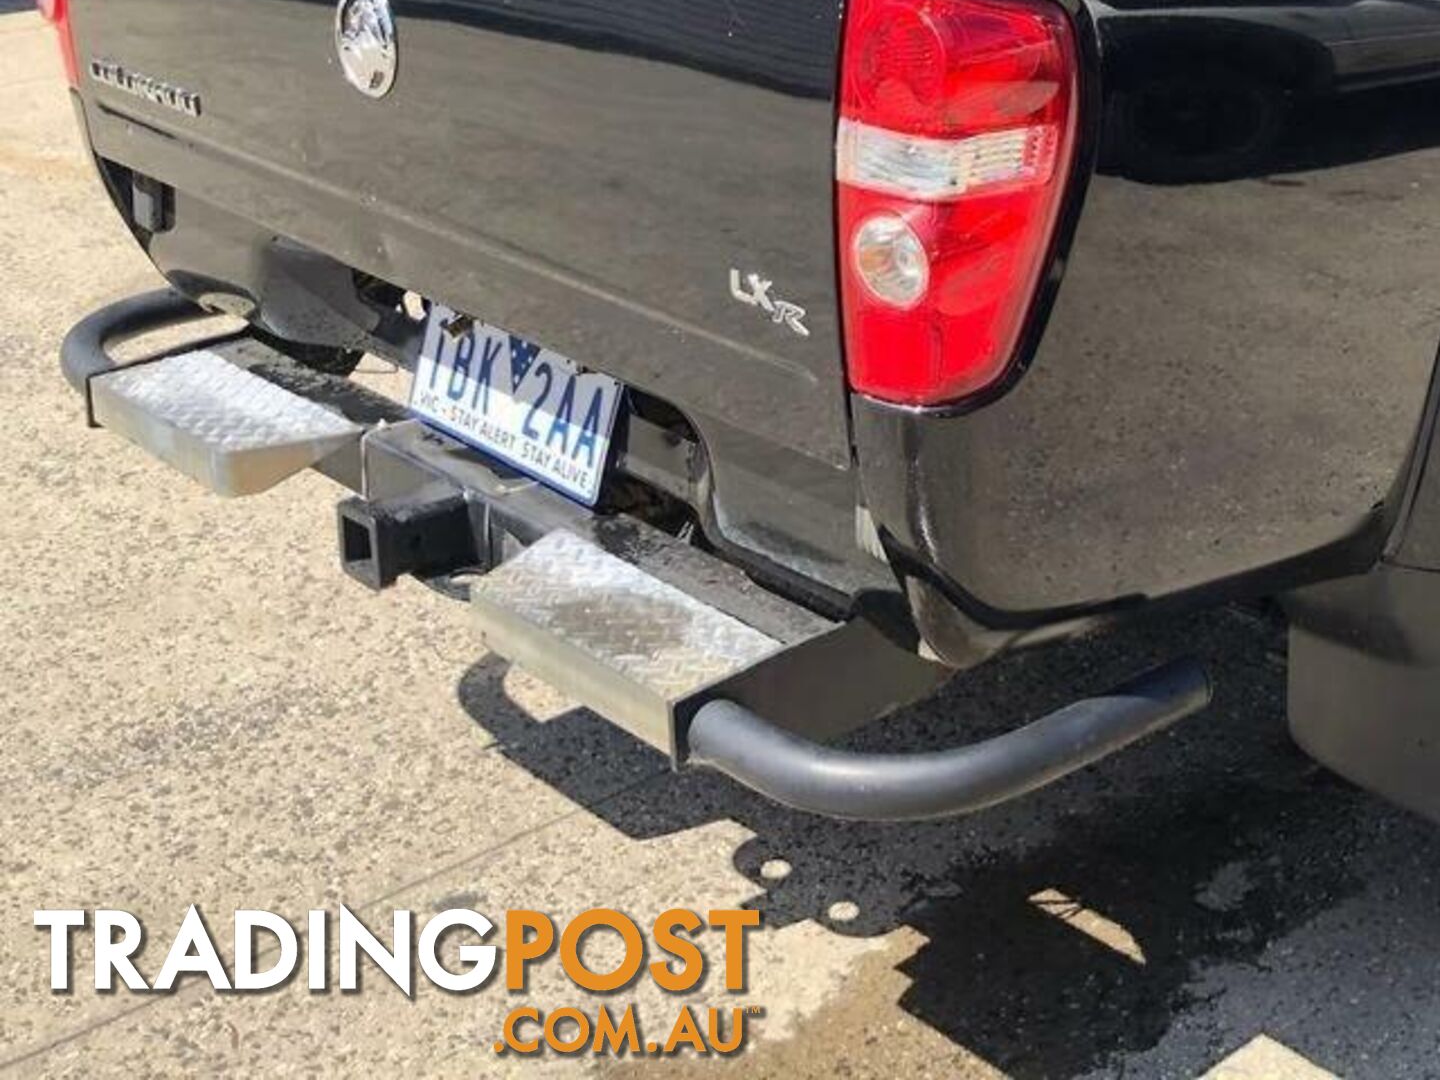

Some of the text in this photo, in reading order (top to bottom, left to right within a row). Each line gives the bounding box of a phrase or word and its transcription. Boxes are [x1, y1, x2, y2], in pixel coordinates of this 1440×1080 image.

[450, 404, 479, 431] STAY
[479, 422, 515, 452] ALERT
[522, 442, 552, 467] STAY
[553, 457, 589, 490] ALIVE
[522, 361, 603, 468] 2AA
